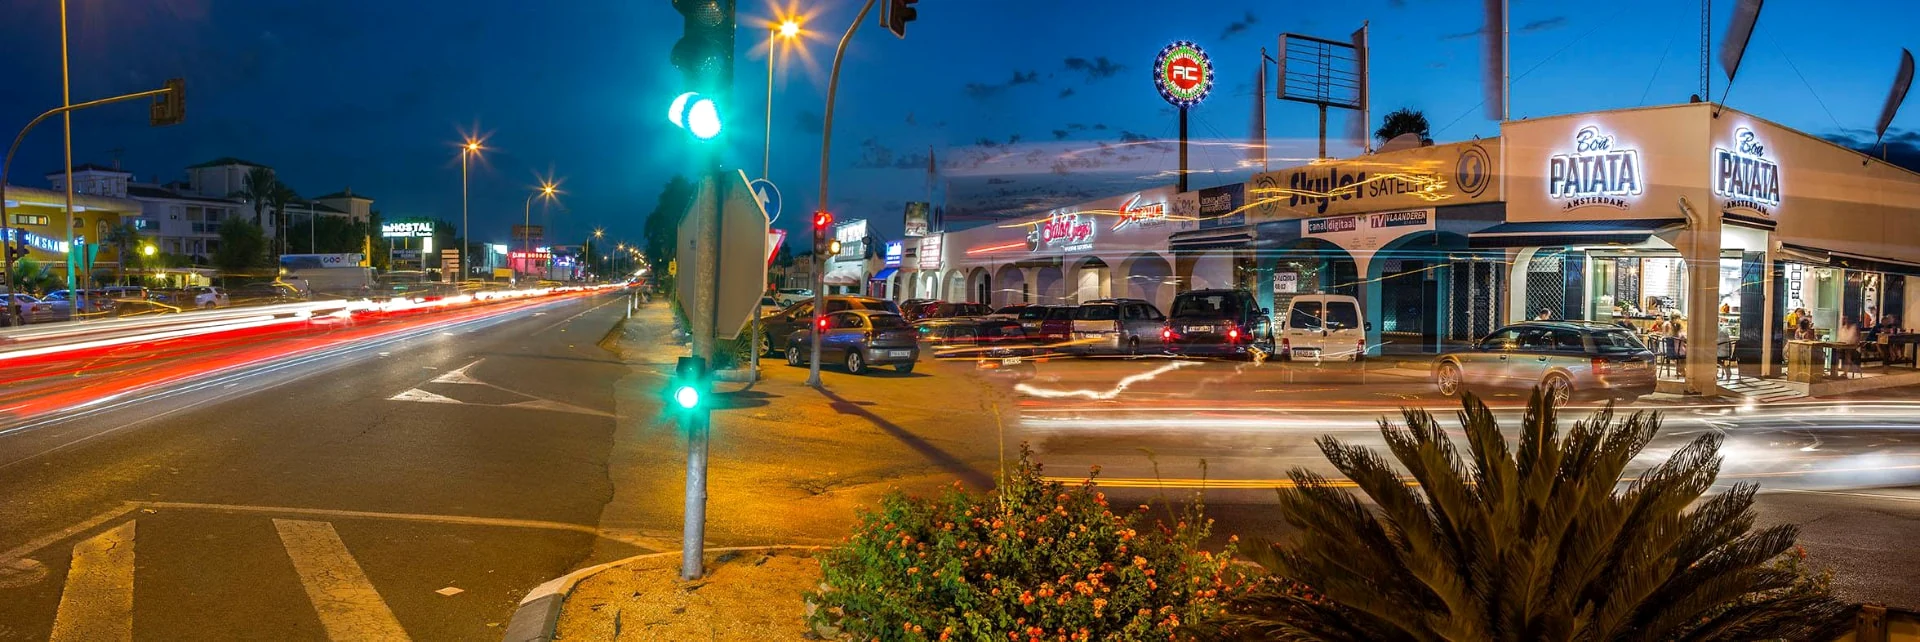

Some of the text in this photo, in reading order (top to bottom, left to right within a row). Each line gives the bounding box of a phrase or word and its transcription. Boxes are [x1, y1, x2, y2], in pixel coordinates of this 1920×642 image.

[1172, 65, 1198, 81] RC
[1576, 130, 1611, 153] Bon
[1739, 131, 1764, 157] Bon
[1550, 153, 1636, 195] PATATA
[1718, 151, 1780, 202] PATATA
[1309, 218, 1356, 232] canal digitaal
[1372, 211, 1427, 228] TV VLAANDEREN
